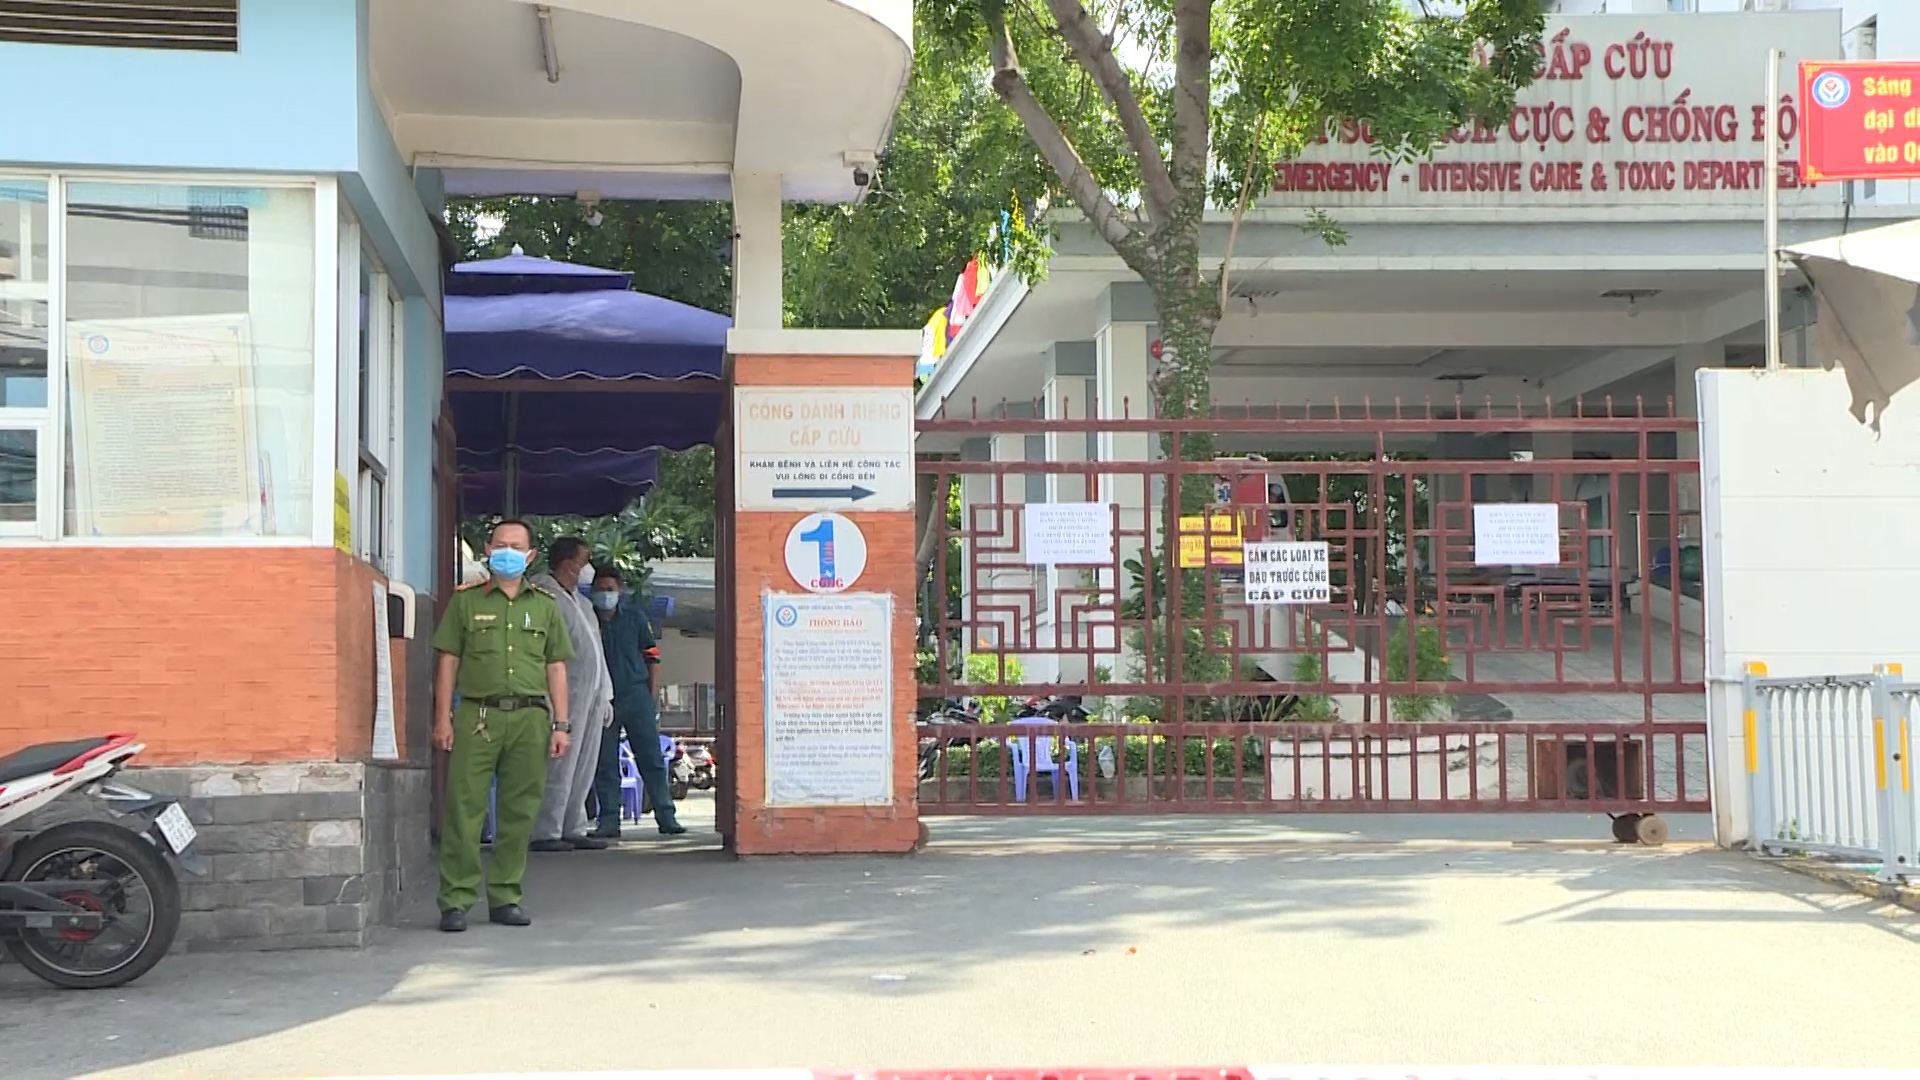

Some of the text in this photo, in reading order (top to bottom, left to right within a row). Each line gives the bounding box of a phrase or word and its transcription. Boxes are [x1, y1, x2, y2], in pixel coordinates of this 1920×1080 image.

[1604, 31, 1673, 80] CỨU
[1863, 76, 1911, 98] Sáng
[1508, 101, 1574, 151] CỰC
[1586, 107, 1610, 144] &
[1622, 88, 1739, 142] CHỐNG
[1864, 142, 1898, 164] vào
[1273, 161, 1392, 192] EMERGENCY
[1419, 161, 1521, 192] INTENSIVE
[1529, 161, 1583, 191] CARE
[1591, 161, 1607, 191] &
[1615, 161, 1676, 191] TOXIC
[789, 424, 861, 446] CẤP CỨU
[800, 519, 835, 587] 1
[1270, 546, 1288, 562] CÁC
[1313, 548, 1326, 562] XE
[1248, 585, 1327, 600] CẤP CỨU
